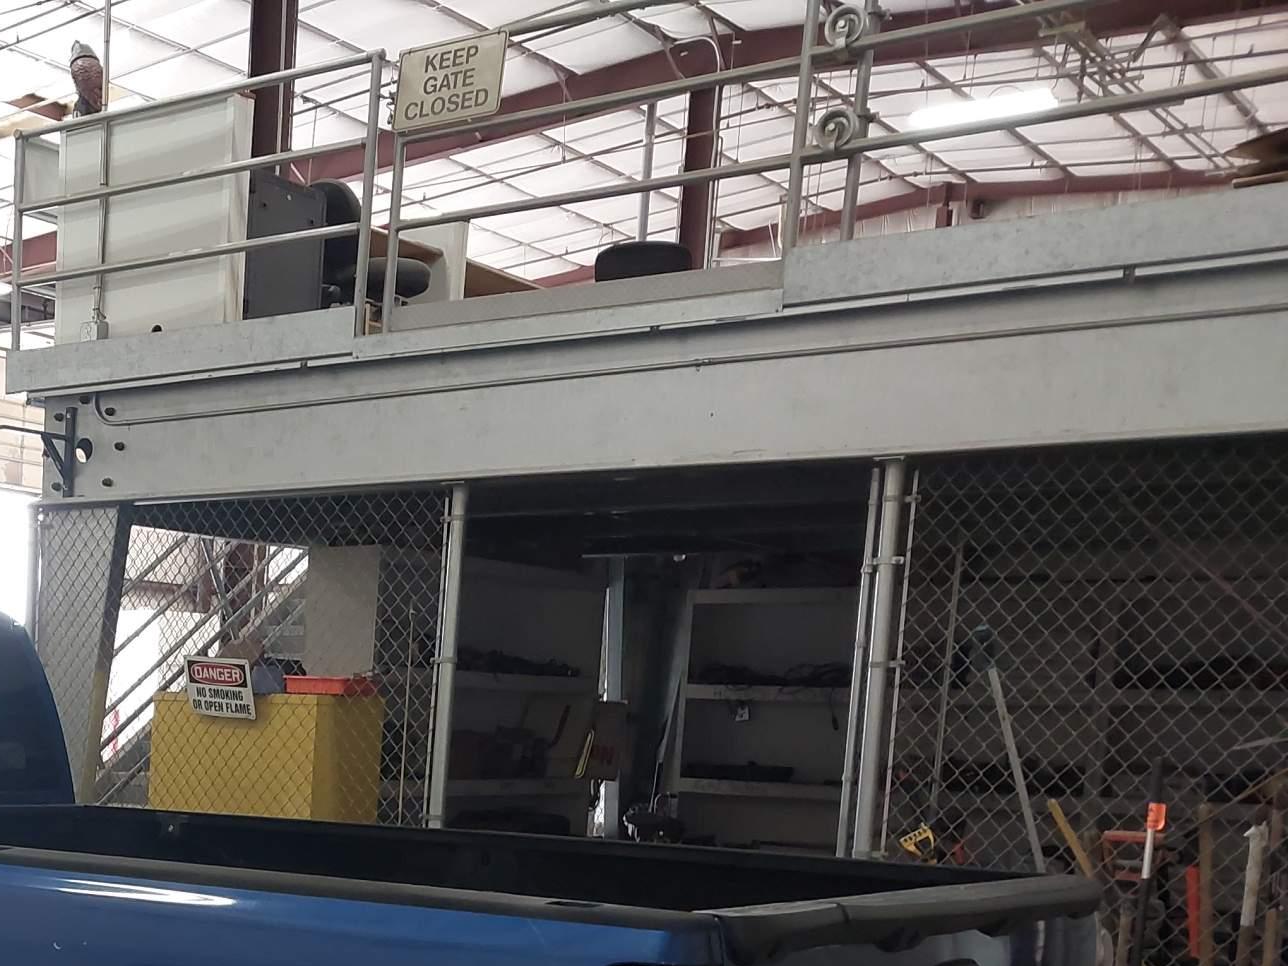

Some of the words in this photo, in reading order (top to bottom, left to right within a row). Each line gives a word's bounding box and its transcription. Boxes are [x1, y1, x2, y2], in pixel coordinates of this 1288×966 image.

[424, 45, 479, 74] KEEP
[423, 67, 476, 95] GATE
[404, 88, 489, 121] CLOSED
[194, 666, 241, 682] DANGER
[196, 686, 207, 698] NO
[208, 687, 244, 702] SMOKING
[192, 698, 203, 710] OR
[204, 700, 224, 713] OPEN
[225, 702, 252, 716] FLAME
